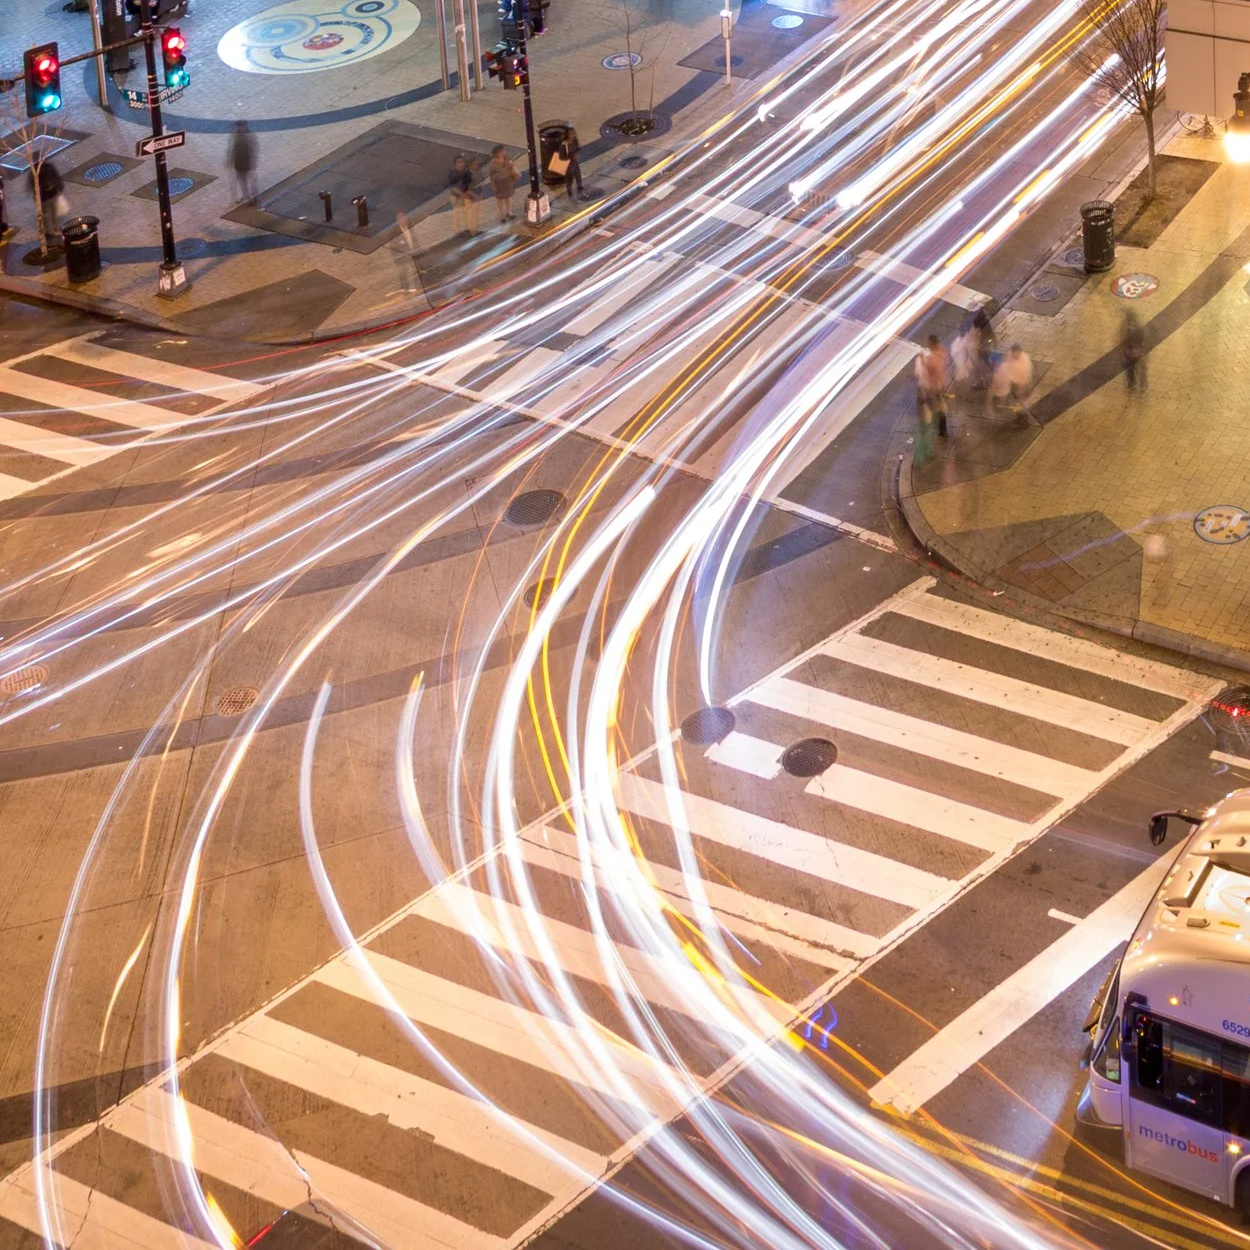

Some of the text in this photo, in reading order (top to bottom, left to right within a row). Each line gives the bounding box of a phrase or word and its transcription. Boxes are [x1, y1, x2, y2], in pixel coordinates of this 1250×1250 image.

[127, 91, 138, 100] 14
[153, 136, 180, 149] ONE WAY
[1222, 1019, 1250, 1039] 6529
[1139, 1124, 1219, 1164] metrobus
